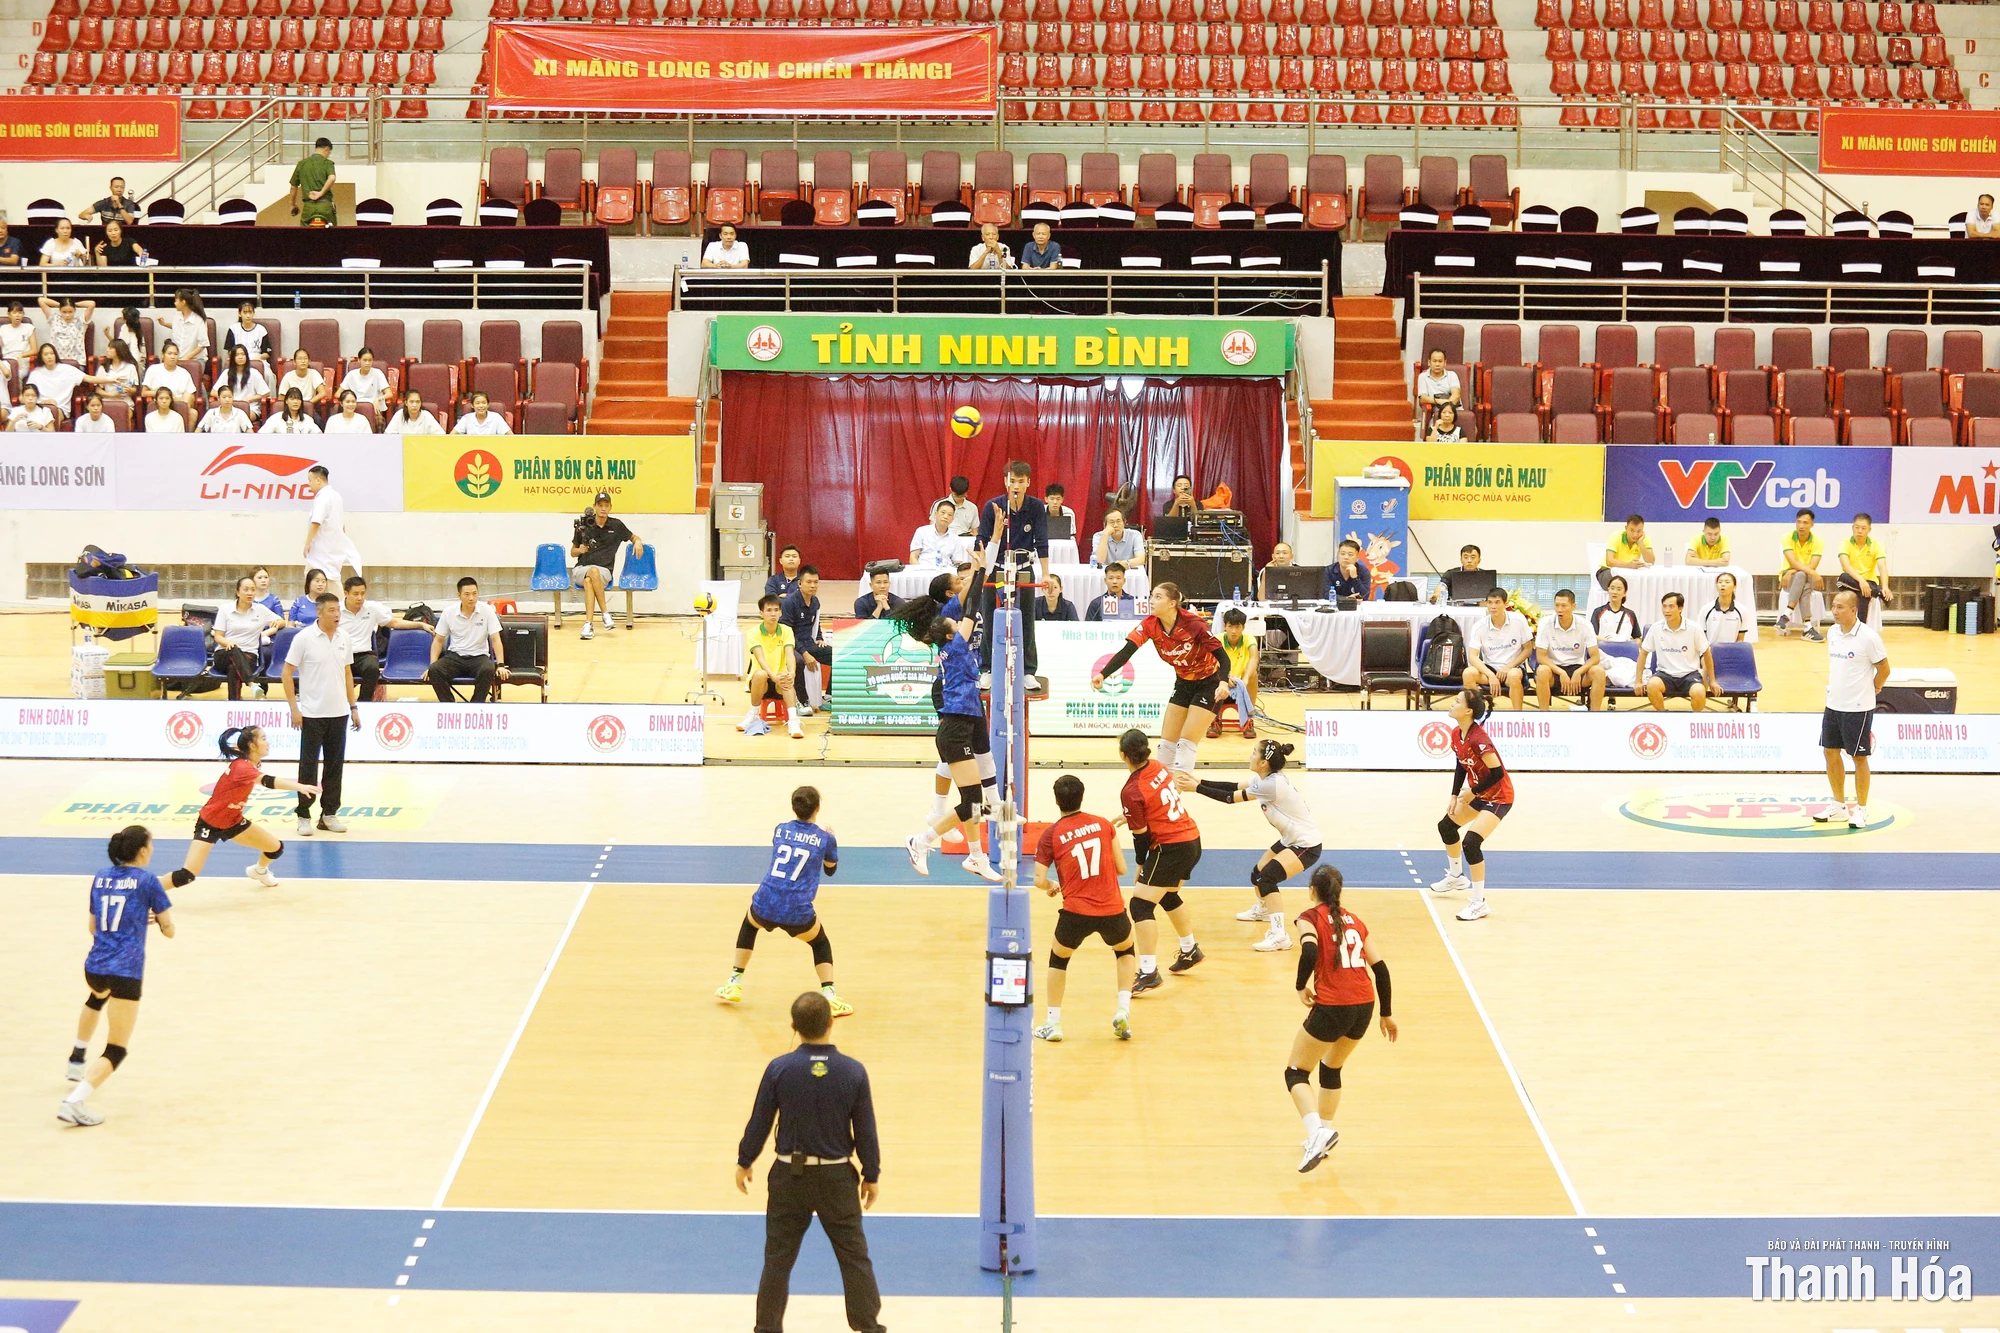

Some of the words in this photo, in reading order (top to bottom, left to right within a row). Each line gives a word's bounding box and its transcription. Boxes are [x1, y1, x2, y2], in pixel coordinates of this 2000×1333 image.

[533, 59, 557, 76] XI
[566, 57, 639, 78] MĂNG
[647, 60, 711, 79] LONG
[719, 58, 770, 80] SƠN
[778, 56, 852, 80] CHIẾN
[864, 57, 952, 80] THẮNG!
[10, 124, 42, 138] LONG
[45, 122, 70, 138] SƠN
[74, 120, 110, 138] CHIẾN
[114, 120, 159, 138] THẮNG!
[1841, 136, 1854, 150] XI
[1857, 134, 1893, 151] MĂNG
[1897, 138, 1928, 152] LONG
[1932, 136, 1956, 152] SƠN
[1960, 135, 1997, 153] CHIẾN
[811, 323, 921, 366] TỈNH
[939, 335, 1058, 367] NINH
[1075, 328, 1189, 367] BÌNH
[30, 466, 69, 486] LONG
[74, 464, 105, 487] SƠN
[514, 456, 550, 480] PHÂN
[555, 455, 581, 480] BÓN
[585, 456, 604, 480] CÀ
[607, 459, 636, 480] MAU
[1424, 463, 1461, 487] PHÂN
[1465, 463, 1492, 488] BÓN
[1496, 463, 1514, 488] CÀ
[1518, 468, 1546, 488] MAU
[200, 483, 317, 500] LI-NING
[523, 486, 541, 495] HẠT
[542, 486, 571, 496] NGỌC
[573, 484, 593, 495] MÙA
[596, 484, 622, 495] VÀNG
[1433, 493, 1451, 503] HẠT
[1452, 494, 1480, 503] NGỌC
[1483, 492, 1503, 502] MÙA
[1505, 492, 1532, 503] VÀNG
[1104, 600, 1117, 614] 20
[1137, 602, 1148, 614] 15
[1062, 630, 1082, 641] Nhà
[1084, 630, 1098, 641] tài
[1101, 631, 1116, 644] trợ
[19, 709, 44, 725] BINH
[46, 707, 75, 726] ĐOÀN
[77, 709, 89, 726] 19
[227, 711, 252, 727] BINH
[437, 712, 461, 730] BINH
[464, 710, 493, 731] ĐOÀN
[496, 713, 509, 731] 19
[649, 714, 674, 732] BINH
[1326, 721, 1338, 737] 19
[1507, 718, 1535, 738] ĐOÀN
[1538, 722, 1551, 738] 19
[1690, 722, 1714, 739] BINH
[1717, 719, 1745, 739] ĐOÀN
[1748, 723, 1760, 739] 19
[1897, 724, 1922, 740] BINH
[1925, 721, 1953, 741] ĐOÀN
[1955, 724, 1968, 741] 19
[771, 844, 810, 882] 27
[1070, 837, 1102, 880] 17
[101, 895, 127, 933] 17
[1332, 928, 1366, 969] 12
